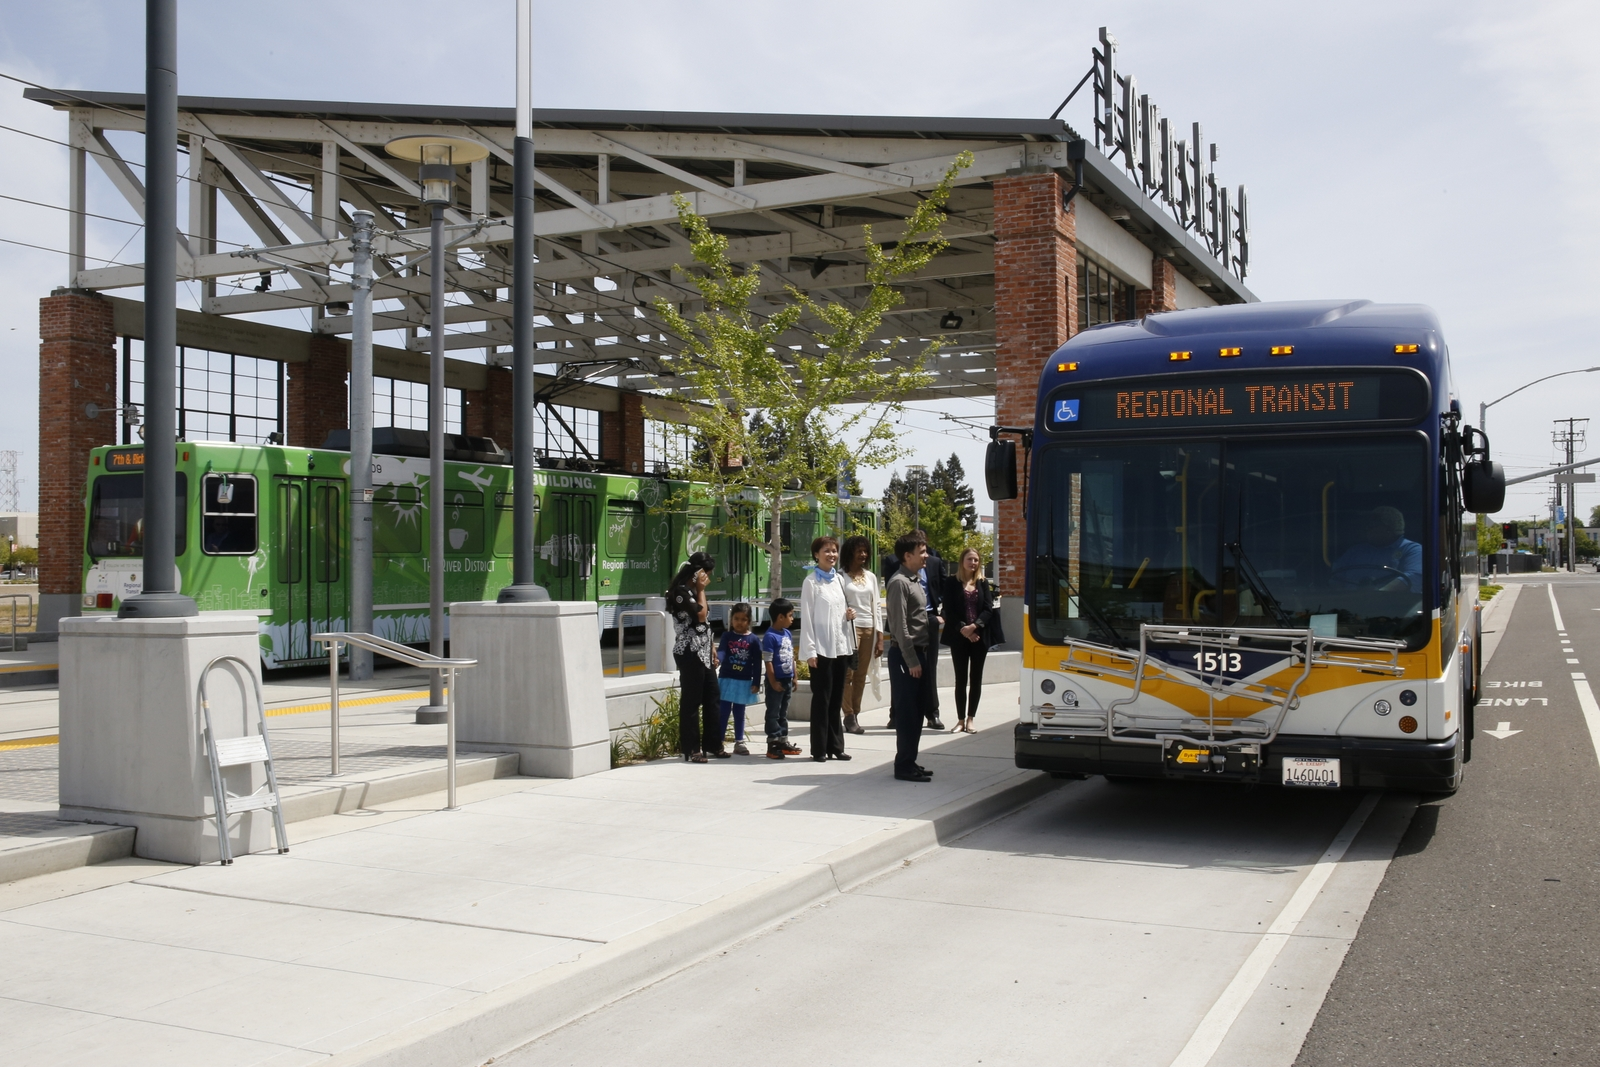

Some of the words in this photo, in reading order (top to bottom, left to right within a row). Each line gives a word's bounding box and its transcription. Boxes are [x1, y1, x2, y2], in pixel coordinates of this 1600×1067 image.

[1117, 388, 1233, 419] REGIONAL
[1245, 381, 1354, 413] TRANSIT
[113, 453, 125, 466] 7th
[125, 453, 132, 465] &
[533, 473, 597, 490] BUILDING.
[464, 557, 496, 573] DISTRICT
[602, 560, 629, 572] Regional
[630, 560, 650, 570] Transit
[732, 664, 745, 672] Day
[1192, 652, 1242, 672] 1513
[1476, 698, 1548, 706] LANE
[1287, 768, 1336, 782] 1460401
